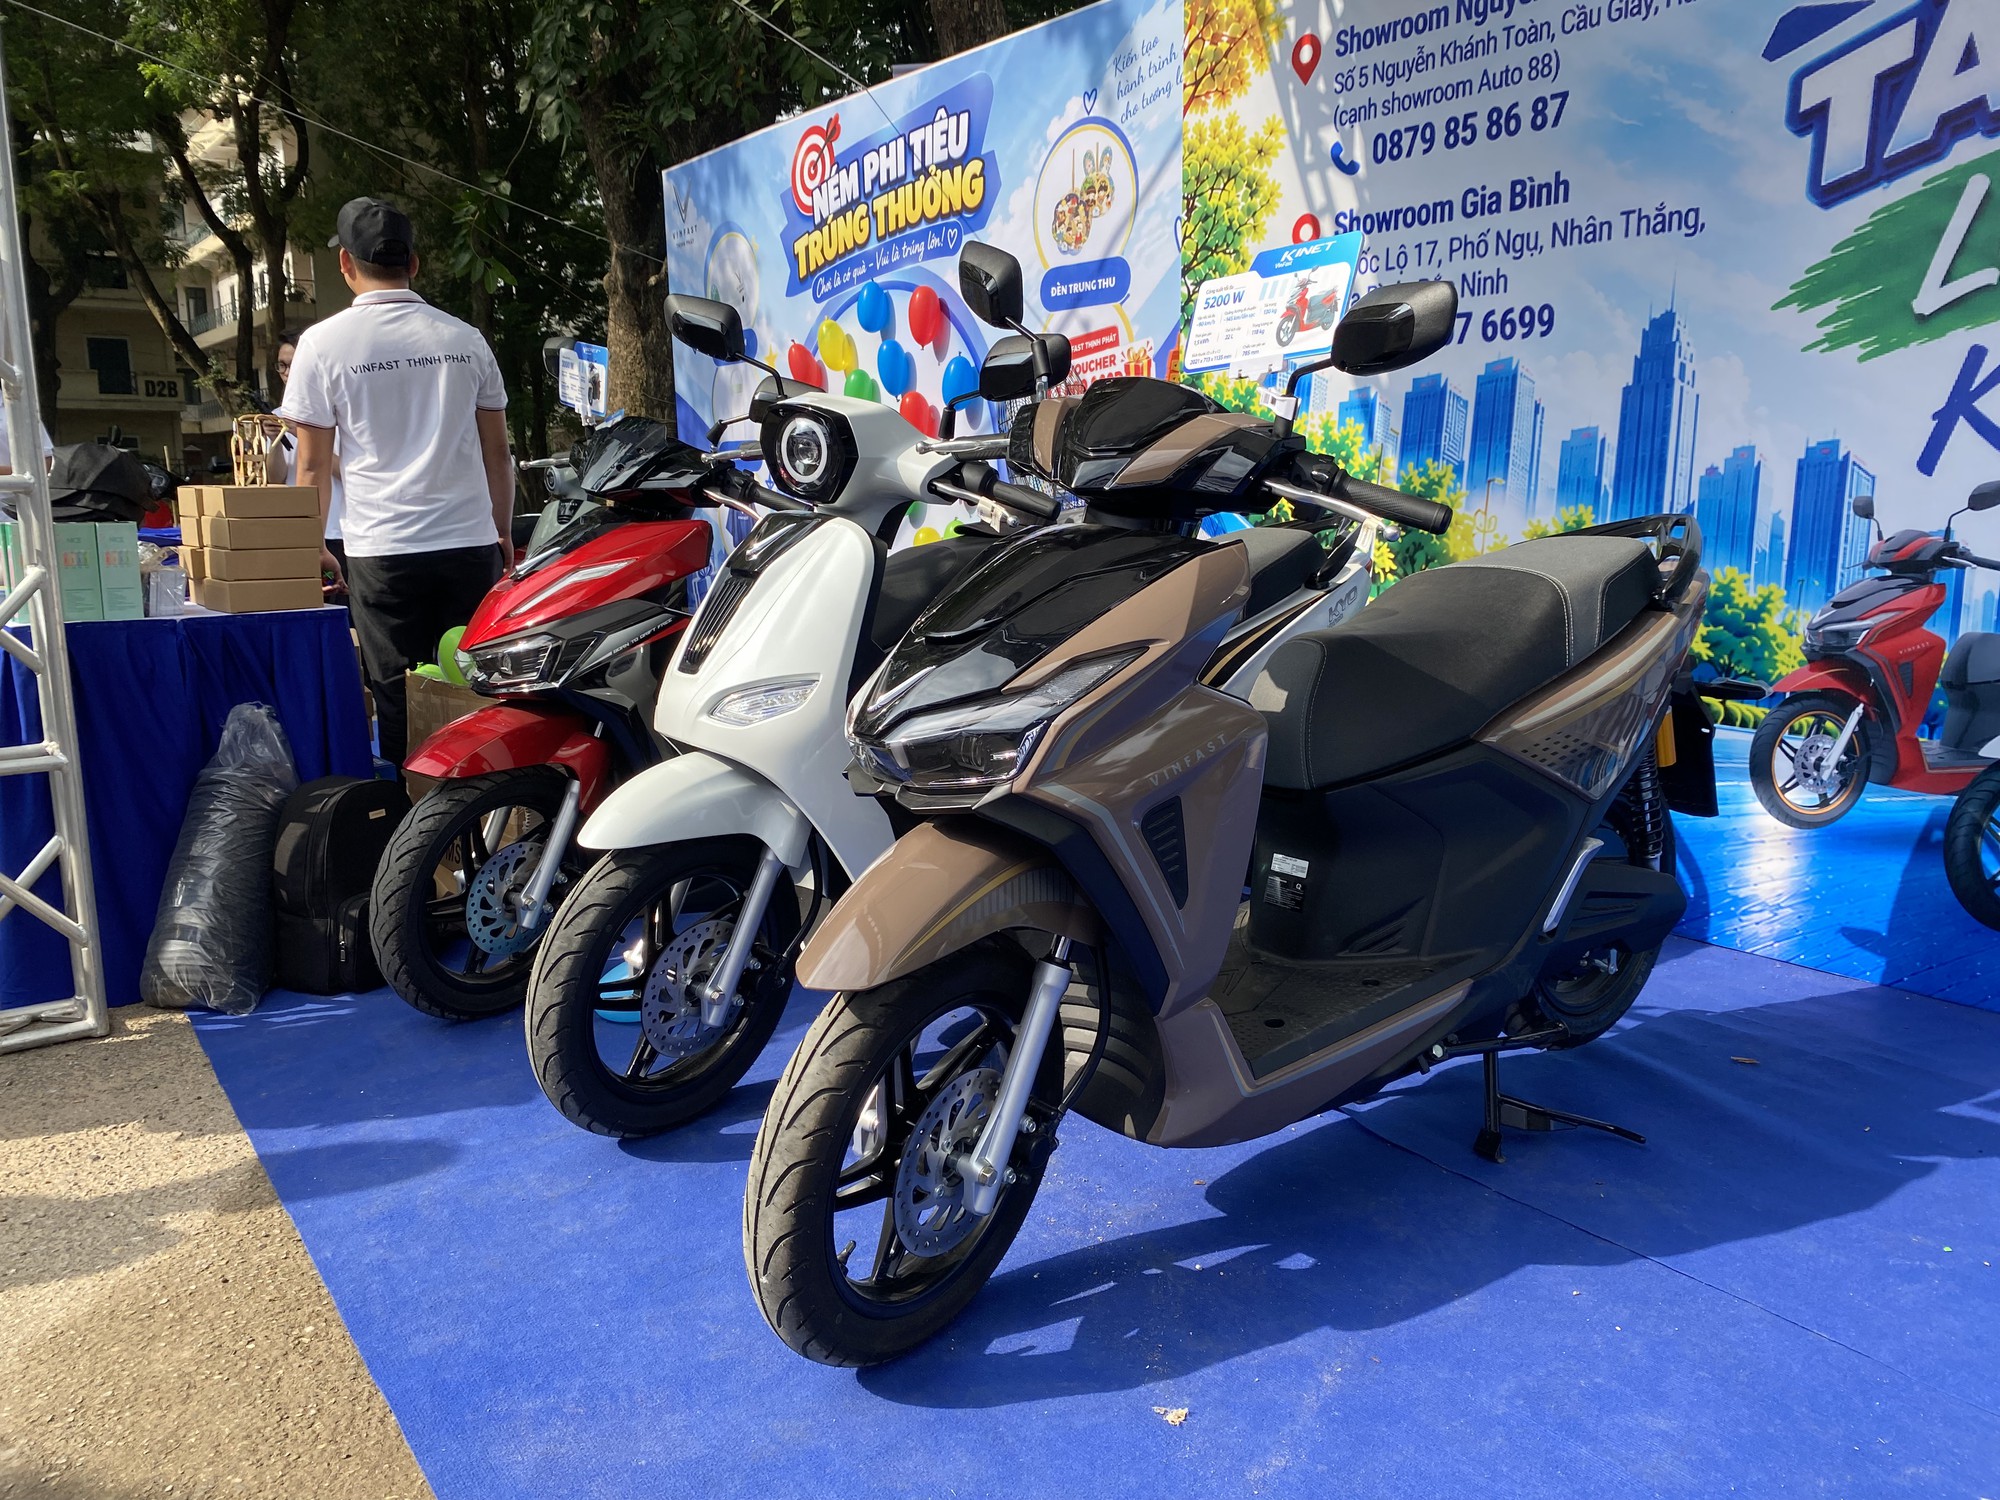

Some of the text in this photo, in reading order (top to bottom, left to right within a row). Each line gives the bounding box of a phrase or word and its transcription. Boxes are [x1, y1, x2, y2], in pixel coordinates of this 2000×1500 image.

[1335, 0, 1539, 57] Showroom Nguy
[1335, 69, 1355, 94] Số
[1358, 67, 1369, 89] 5
[1373, 46, 1436, 88] Nguyễn
[1441, 30, 1498, 67] Khánh
[1502, 19, 1556, 51] Toàn,
[1561, 6, 1601, 35] Cầu
[1117, 65, 1145, 101] hành
[1334, 49, 1560, 132] (cạnh showroom Auto 88)
[1120, 101, 1139, 124] cho
[1372, 91, 1570, 164] 0879 85 86 87
[812, 109, 969, 226] NÉM PHI TIÊU
[794, 160, 984, 279] TRÚNG THƯỞNG
[1335, 171, 1570, 236] Showroom Gia Bình
[672, 225, 698, 240] VINFAST
[1281, 240, 1337, 262] KINET
[1358, 201, 1706, 275] ốc Lộ 17, Phố Ngụ, Nhân Thắng,
[833, 271, 842, 286] là
[875, 247, 890, 270] Vui
[891, 246, 900, 264] là
[1068, 279, 1096, 294] TRUNG
[1097, 276, 1116, 289] THU
[1461, 268, 1508, 298] Ninh
[1203, 290, 1245, 310] 5200 W
[1071, 343, 1084, 353] FAST
[1101, 333, 1117, 345] PHÁT
[1481, 303, 1555, 343] 6699
[350, 353, 472, 375] VINFAST THỊNH PHÁT
[144, 379, 178, 397] D2B
[1149, 733, 1226, 786] VINFAST
